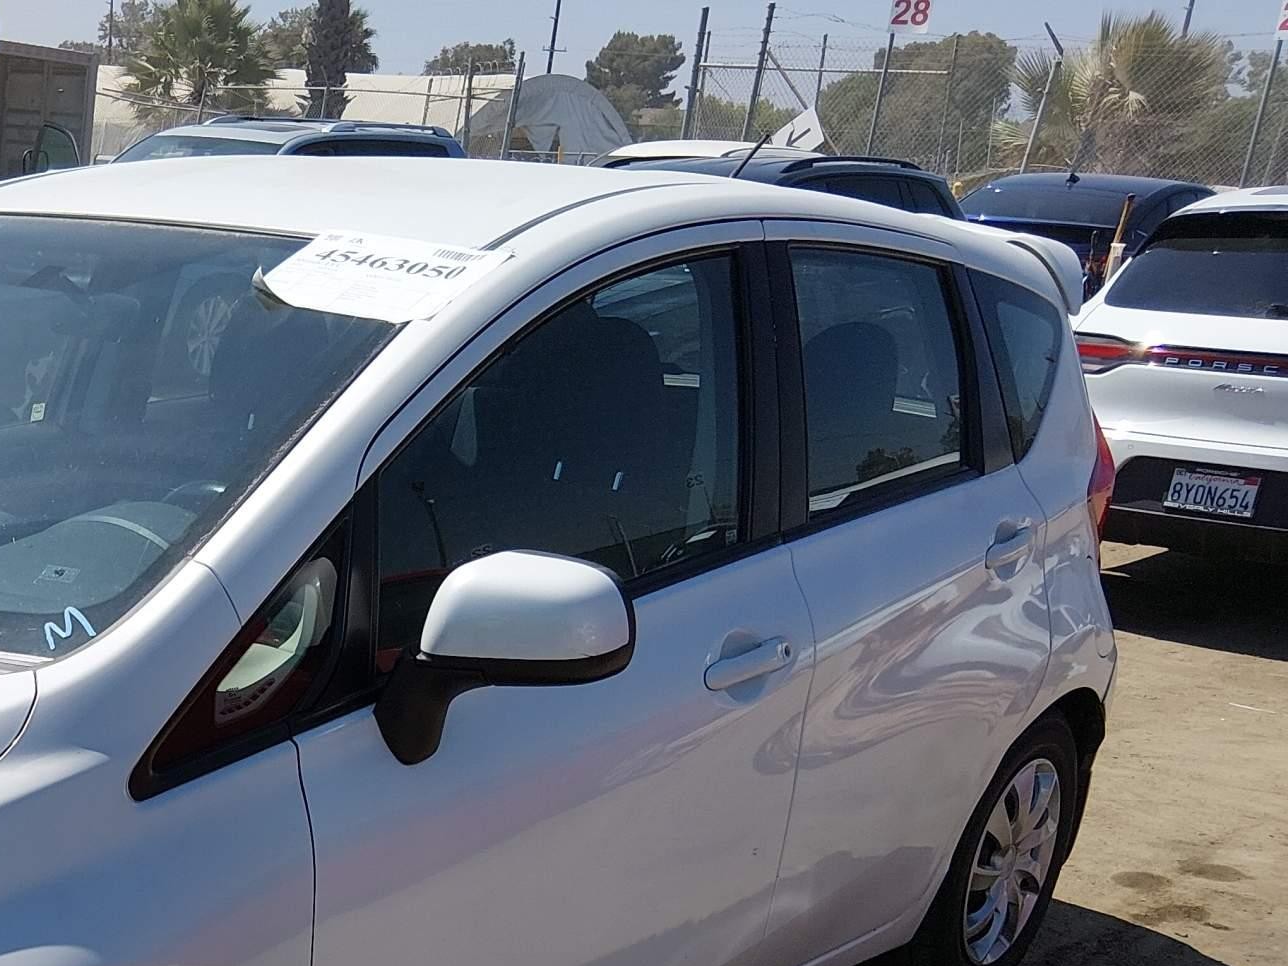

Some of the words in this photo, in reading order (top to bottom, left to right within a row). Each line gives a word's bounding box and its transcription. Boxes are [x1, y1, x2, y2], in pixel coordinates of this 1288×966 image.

[891, 0, 930, 25] 28
[315, 249, 467, 280] 45463050
[1163, 501, 1215, 513] BEVERLY
[1217, 508, 1251, 517] HILLS
[44, 606, 97, 650] M
